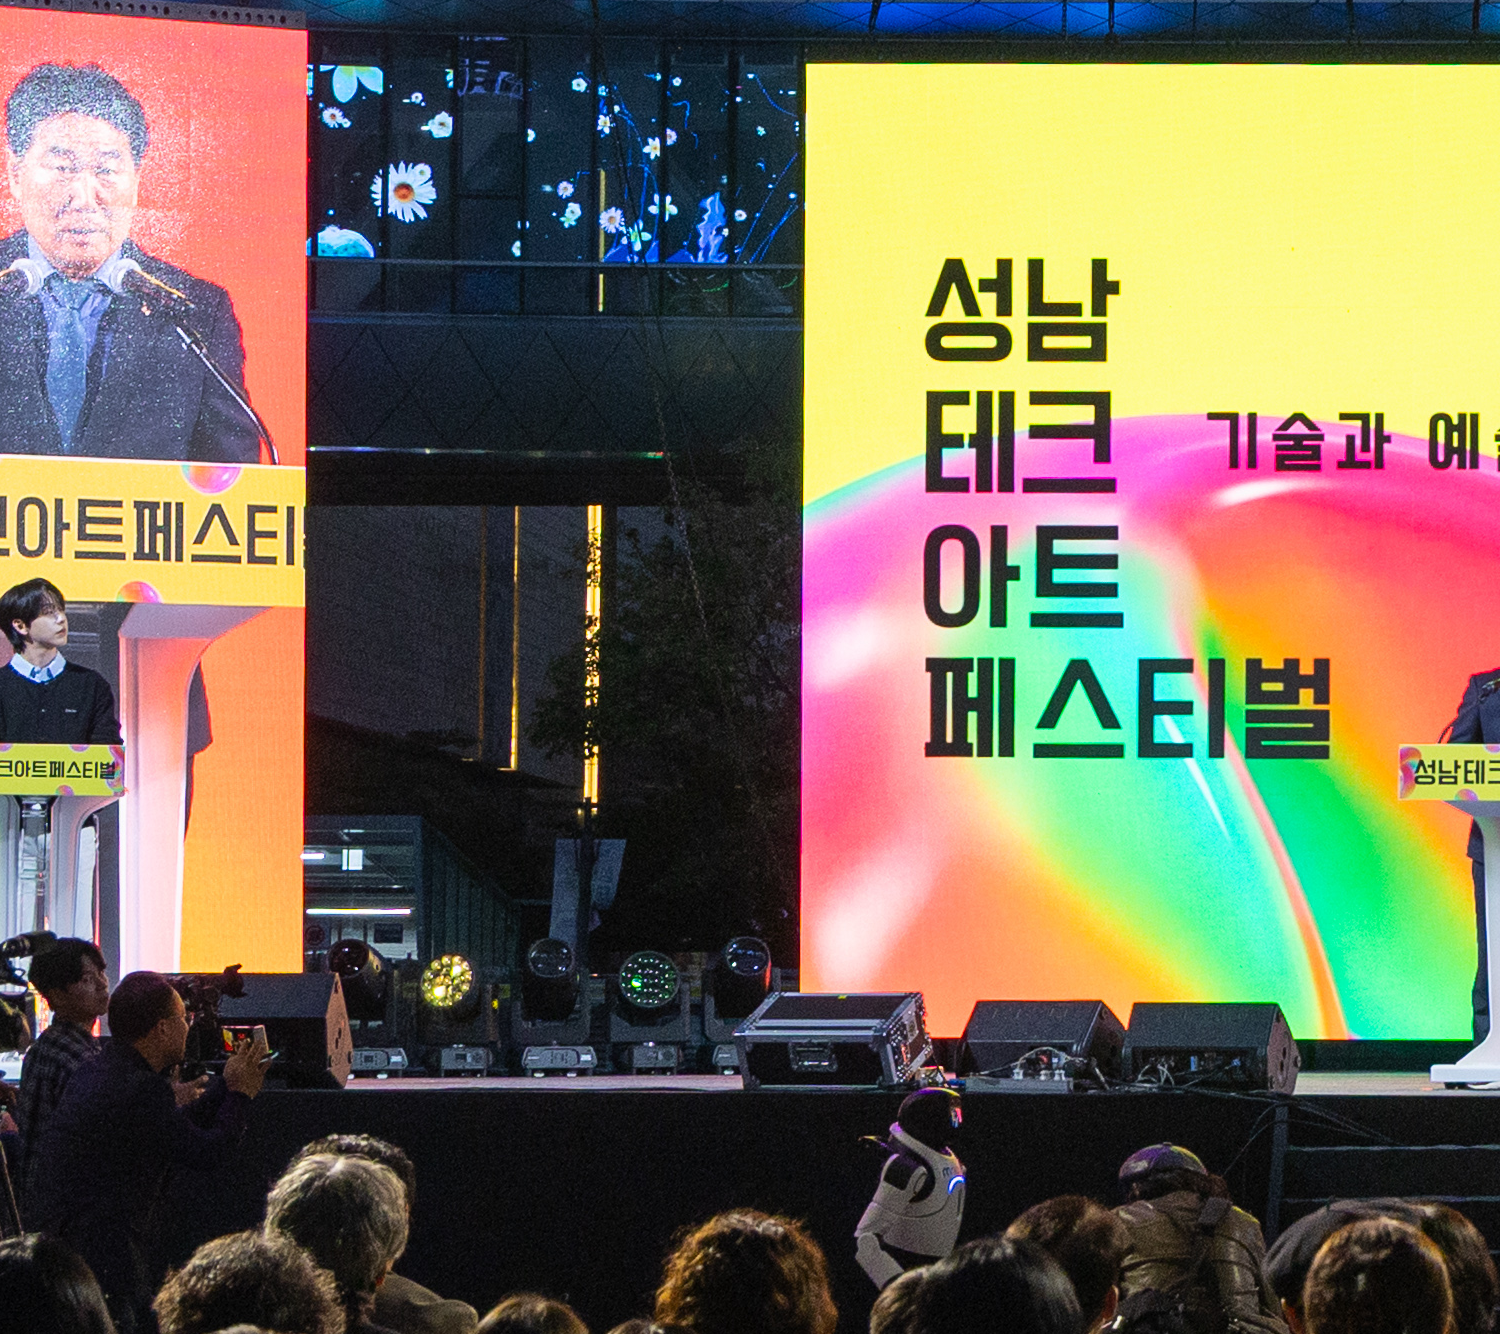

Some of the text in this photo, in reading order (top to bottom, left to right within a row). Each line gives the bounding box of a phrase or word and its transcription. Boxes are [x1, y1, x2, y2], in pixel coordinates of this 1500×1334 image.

[924, 257, 1121, 362] 성남
[925, 390, 1117, 494] 테크
[1206, 411, 1391, 474] 기술과
[923, 524, 1124, 628] 아트
[925, 656, 1330, 760] 페스티벌
